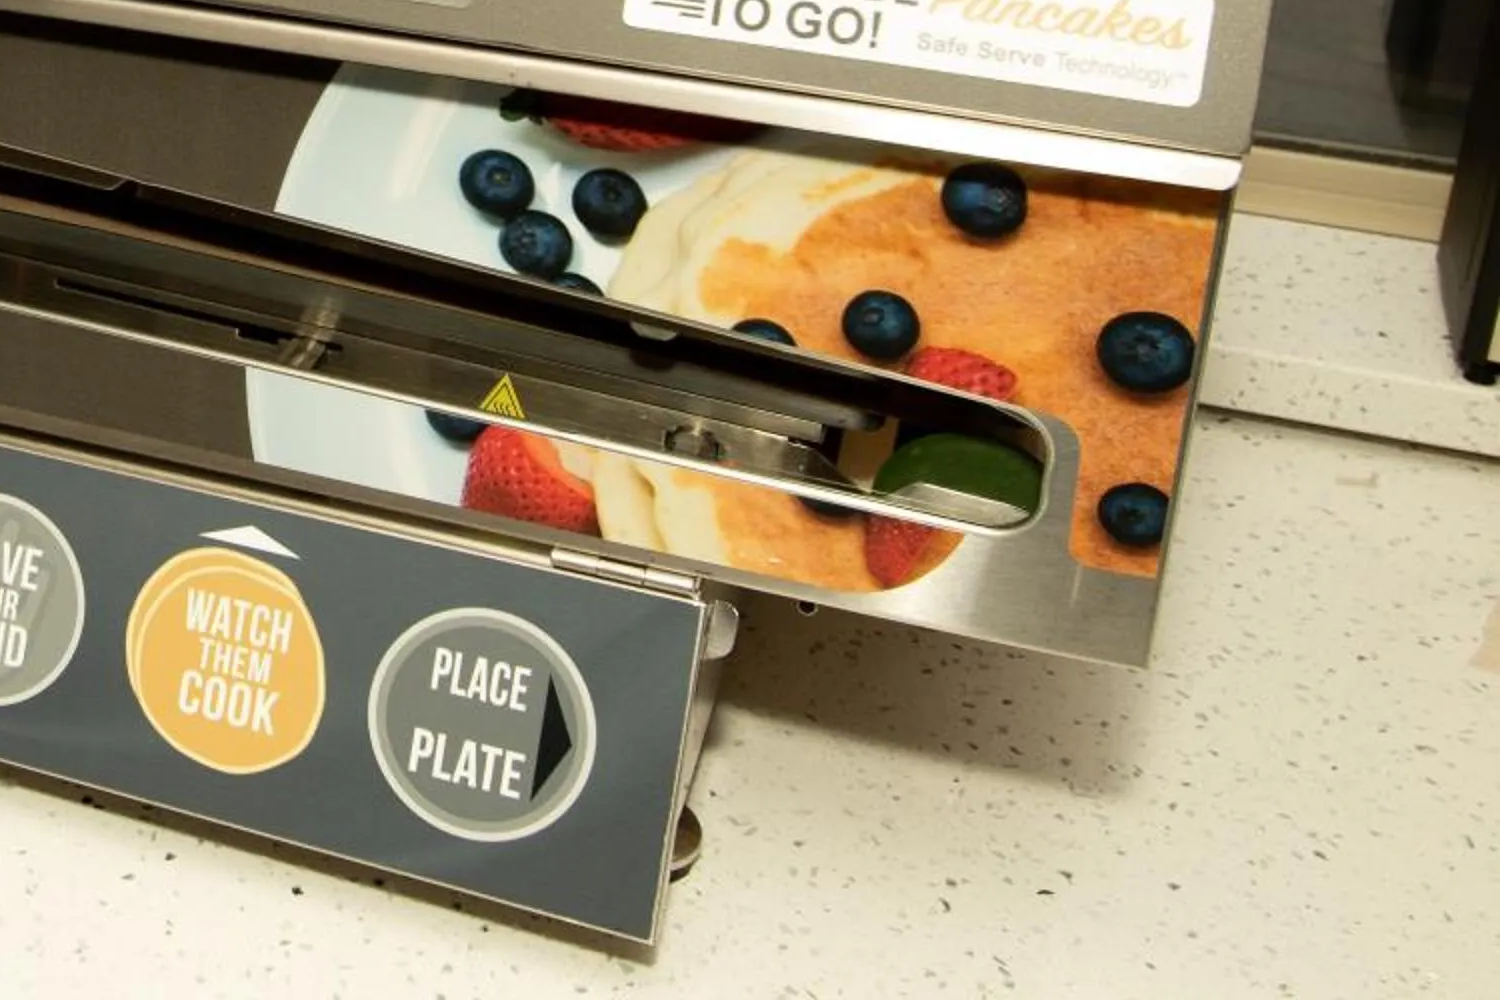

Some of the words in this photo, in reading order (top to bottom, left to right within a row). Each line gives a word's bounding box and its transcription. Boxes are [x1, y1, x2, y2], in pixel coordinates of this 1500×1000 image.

[785, 0, 883, 49] GO!
[916, 31, 968, 57] Safe
[977, 40, 1047, 68] Serve
[185, 587, 293, 655] WATCH
[199, 636, 273, 686] THEM
[430, 647, 533, 713] PLACE
[177, 669, 280, 737] COOK
[407, 727, 528, 800] PLATE
